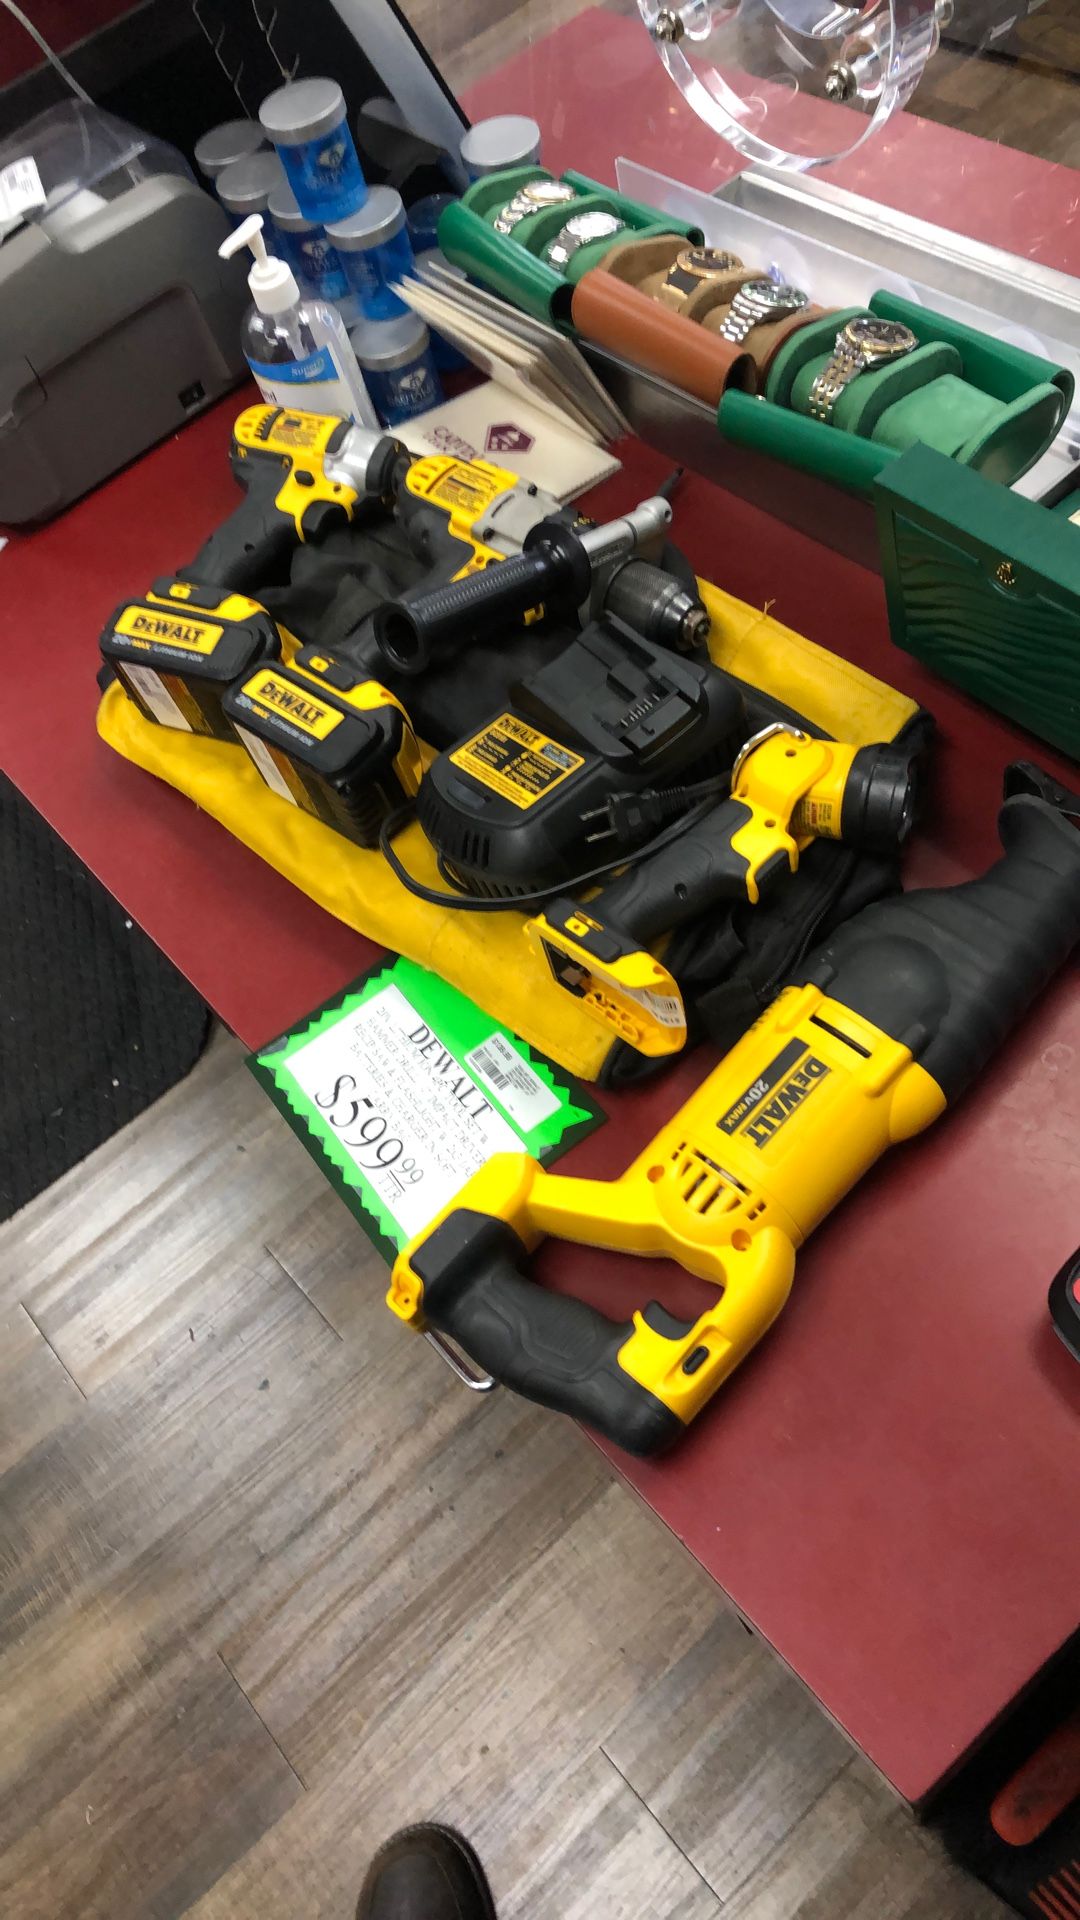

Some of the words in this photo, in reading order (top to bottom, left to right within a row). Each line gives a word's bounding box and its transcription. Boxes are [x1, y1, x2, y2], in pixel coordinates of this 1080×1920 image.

[132, 615, 204, 645] DEWALT
[259, 681, 327, 726] DEWALT
[366, 1015, 401, 1056] HAMMER
[371, 1045, 391, 1068] SAW
[393, 1074, 441, 1134] FLASHLIGHT
[408, 1023, 494, 1118] DEWALT
[743, 1078, 770, 1107] 20V
[390, 1095, 430, 1143] CHARGER
[724, 1101, 749, 1127] MAX
[746, 1056, 829, 1148] DEWALT
[314, 1074, 404, 1169] $599
[398, 1158, 424, 1185] 99
